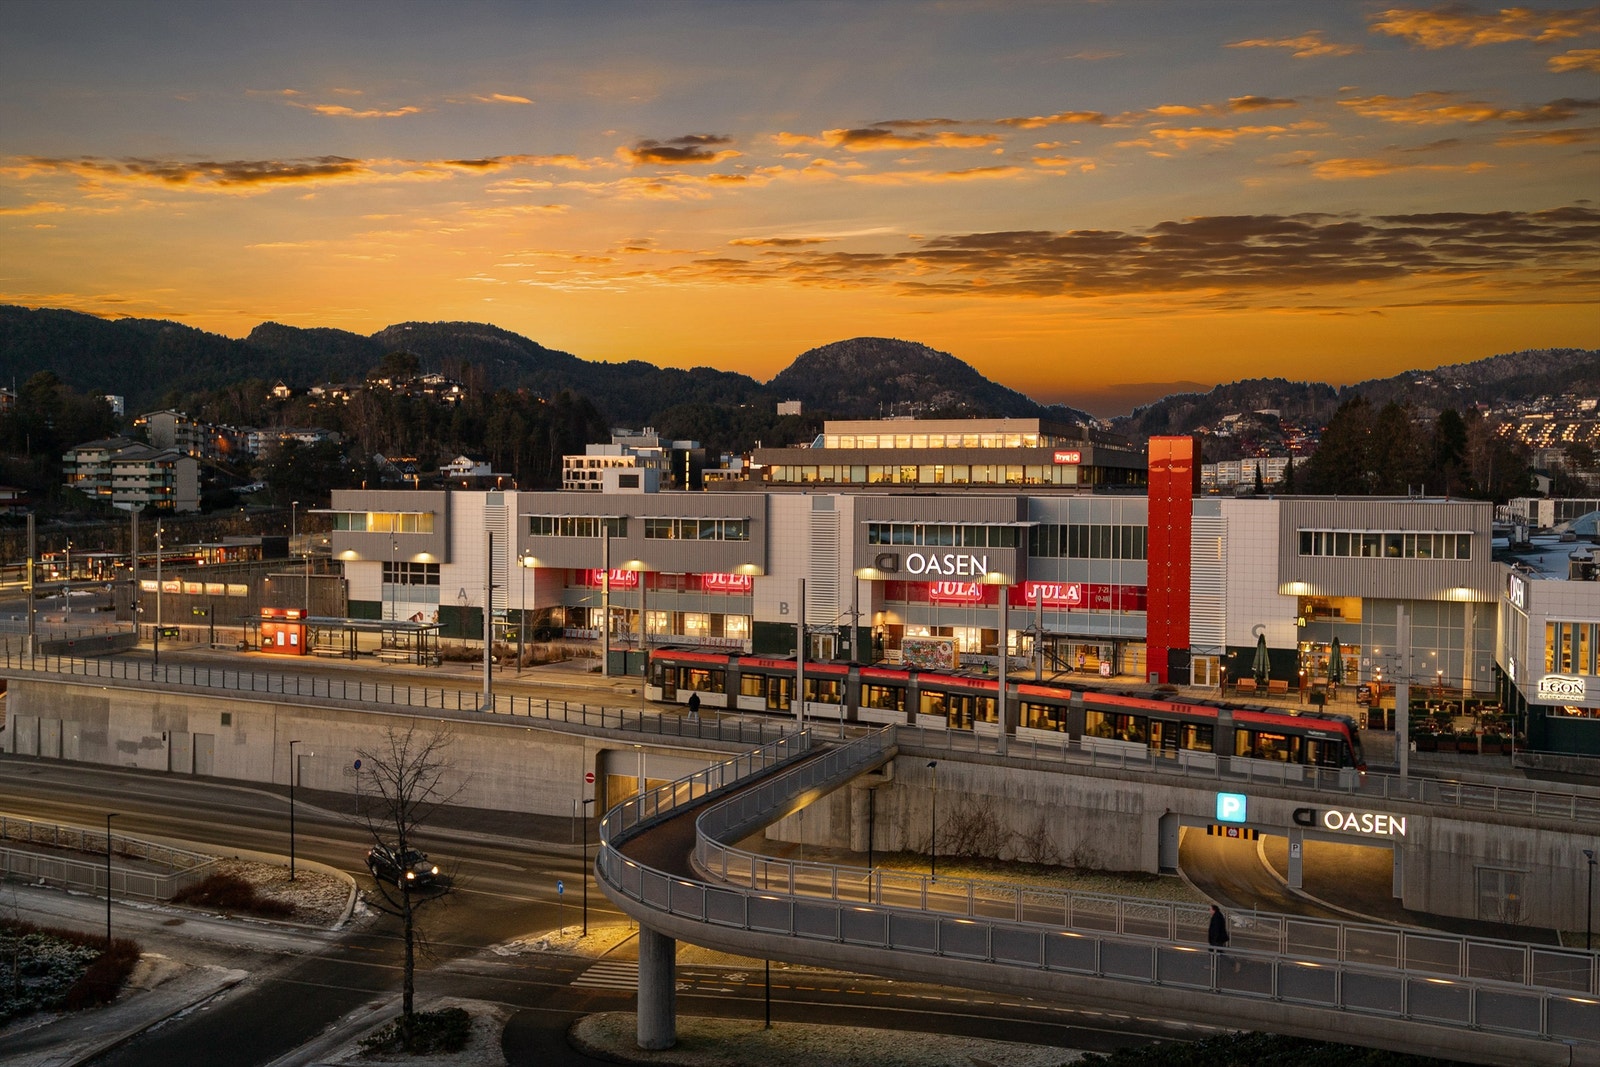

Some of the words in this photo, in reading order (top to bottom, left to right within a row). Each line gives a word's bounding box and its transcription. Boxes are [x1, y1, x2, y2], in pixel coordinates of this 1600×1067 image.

[1055, 454, 1070, 462] Tryg
[906, 553, 987, 576] OASEN
[708, 573, 749, 586] JULA
[457, 587, 468, 600] A
[931, 581, 980, 596] JULA
[1028, 584, 1079, 600] JULA
[780, 601, 790, 615] B
[1251, 623, 1266, 639] C
[1223, 797, 1240, 818] P
[1324, 810, 1406, 836] OASEN
[1292, 844, 1299, 852] P
